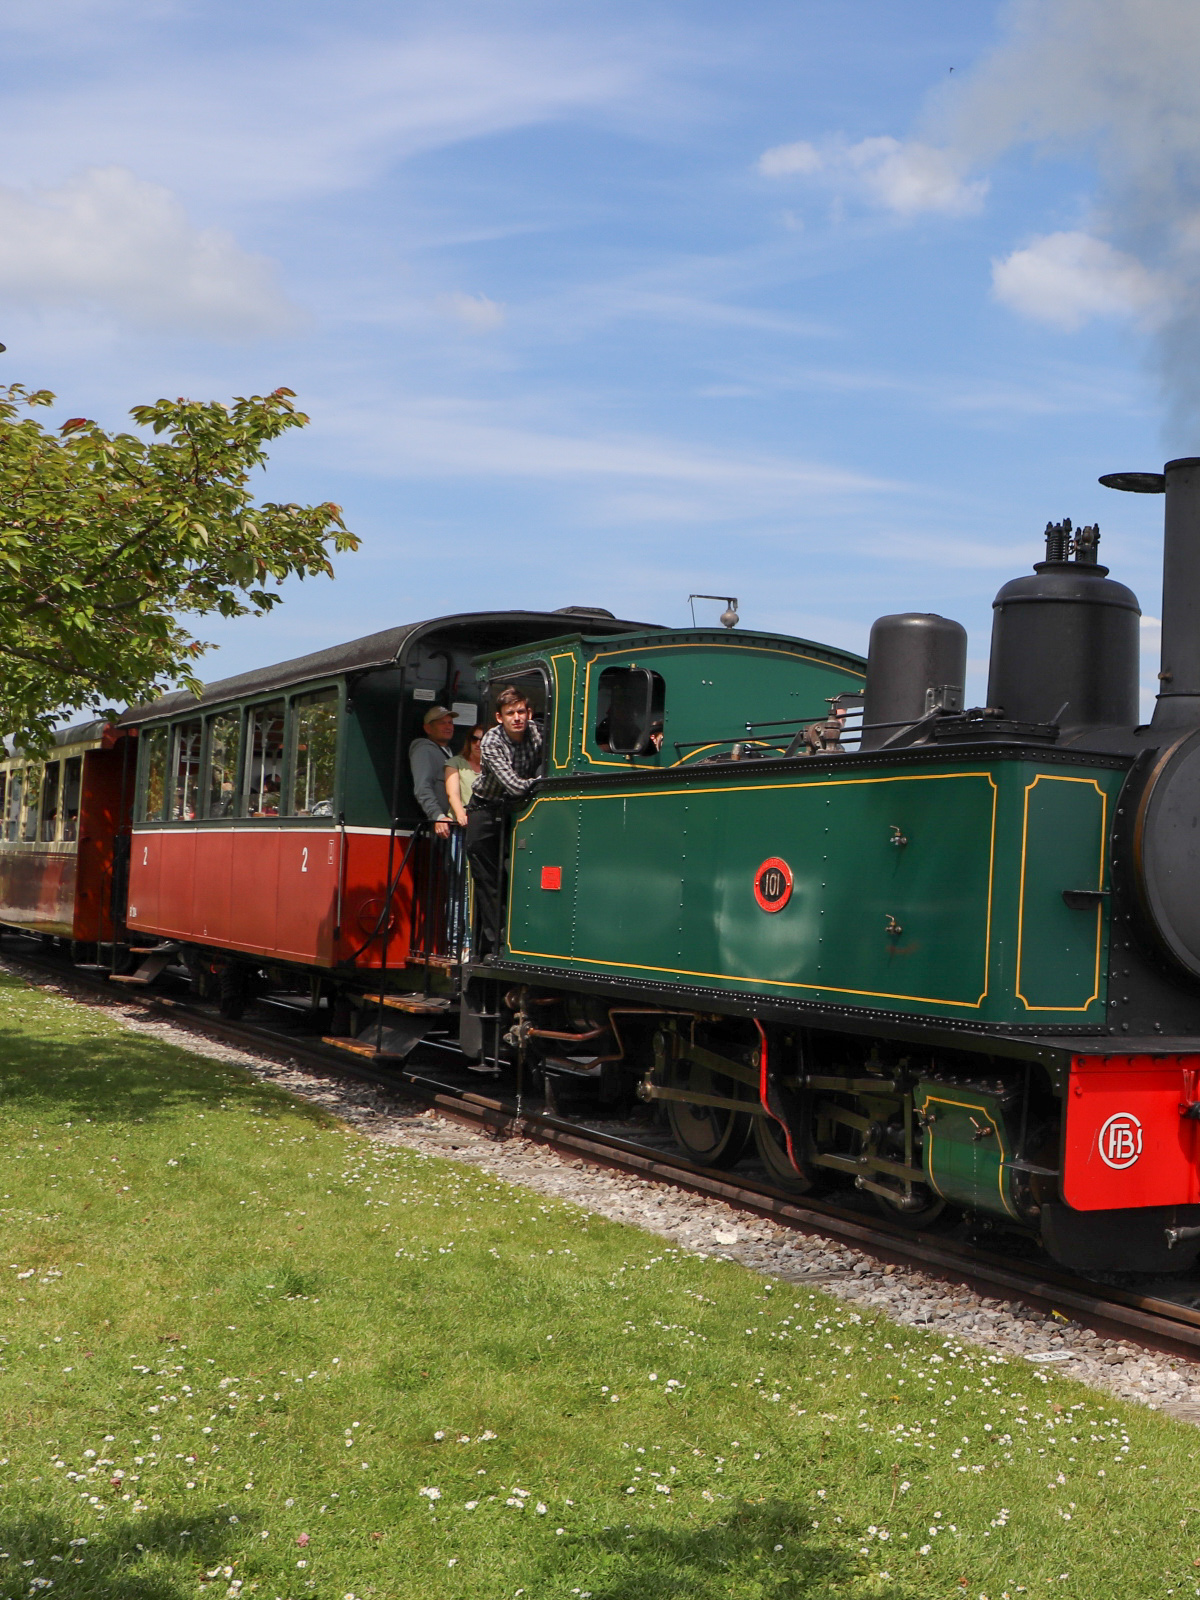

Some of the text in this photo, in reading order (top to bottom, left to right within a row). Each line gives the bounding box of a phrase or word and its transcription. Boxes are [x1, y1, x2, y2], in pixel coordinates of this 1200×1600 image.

[143, 846, 149, 866] 2
[301, 846, 309, 872] 2
[765, 873, 780, 896] 101
